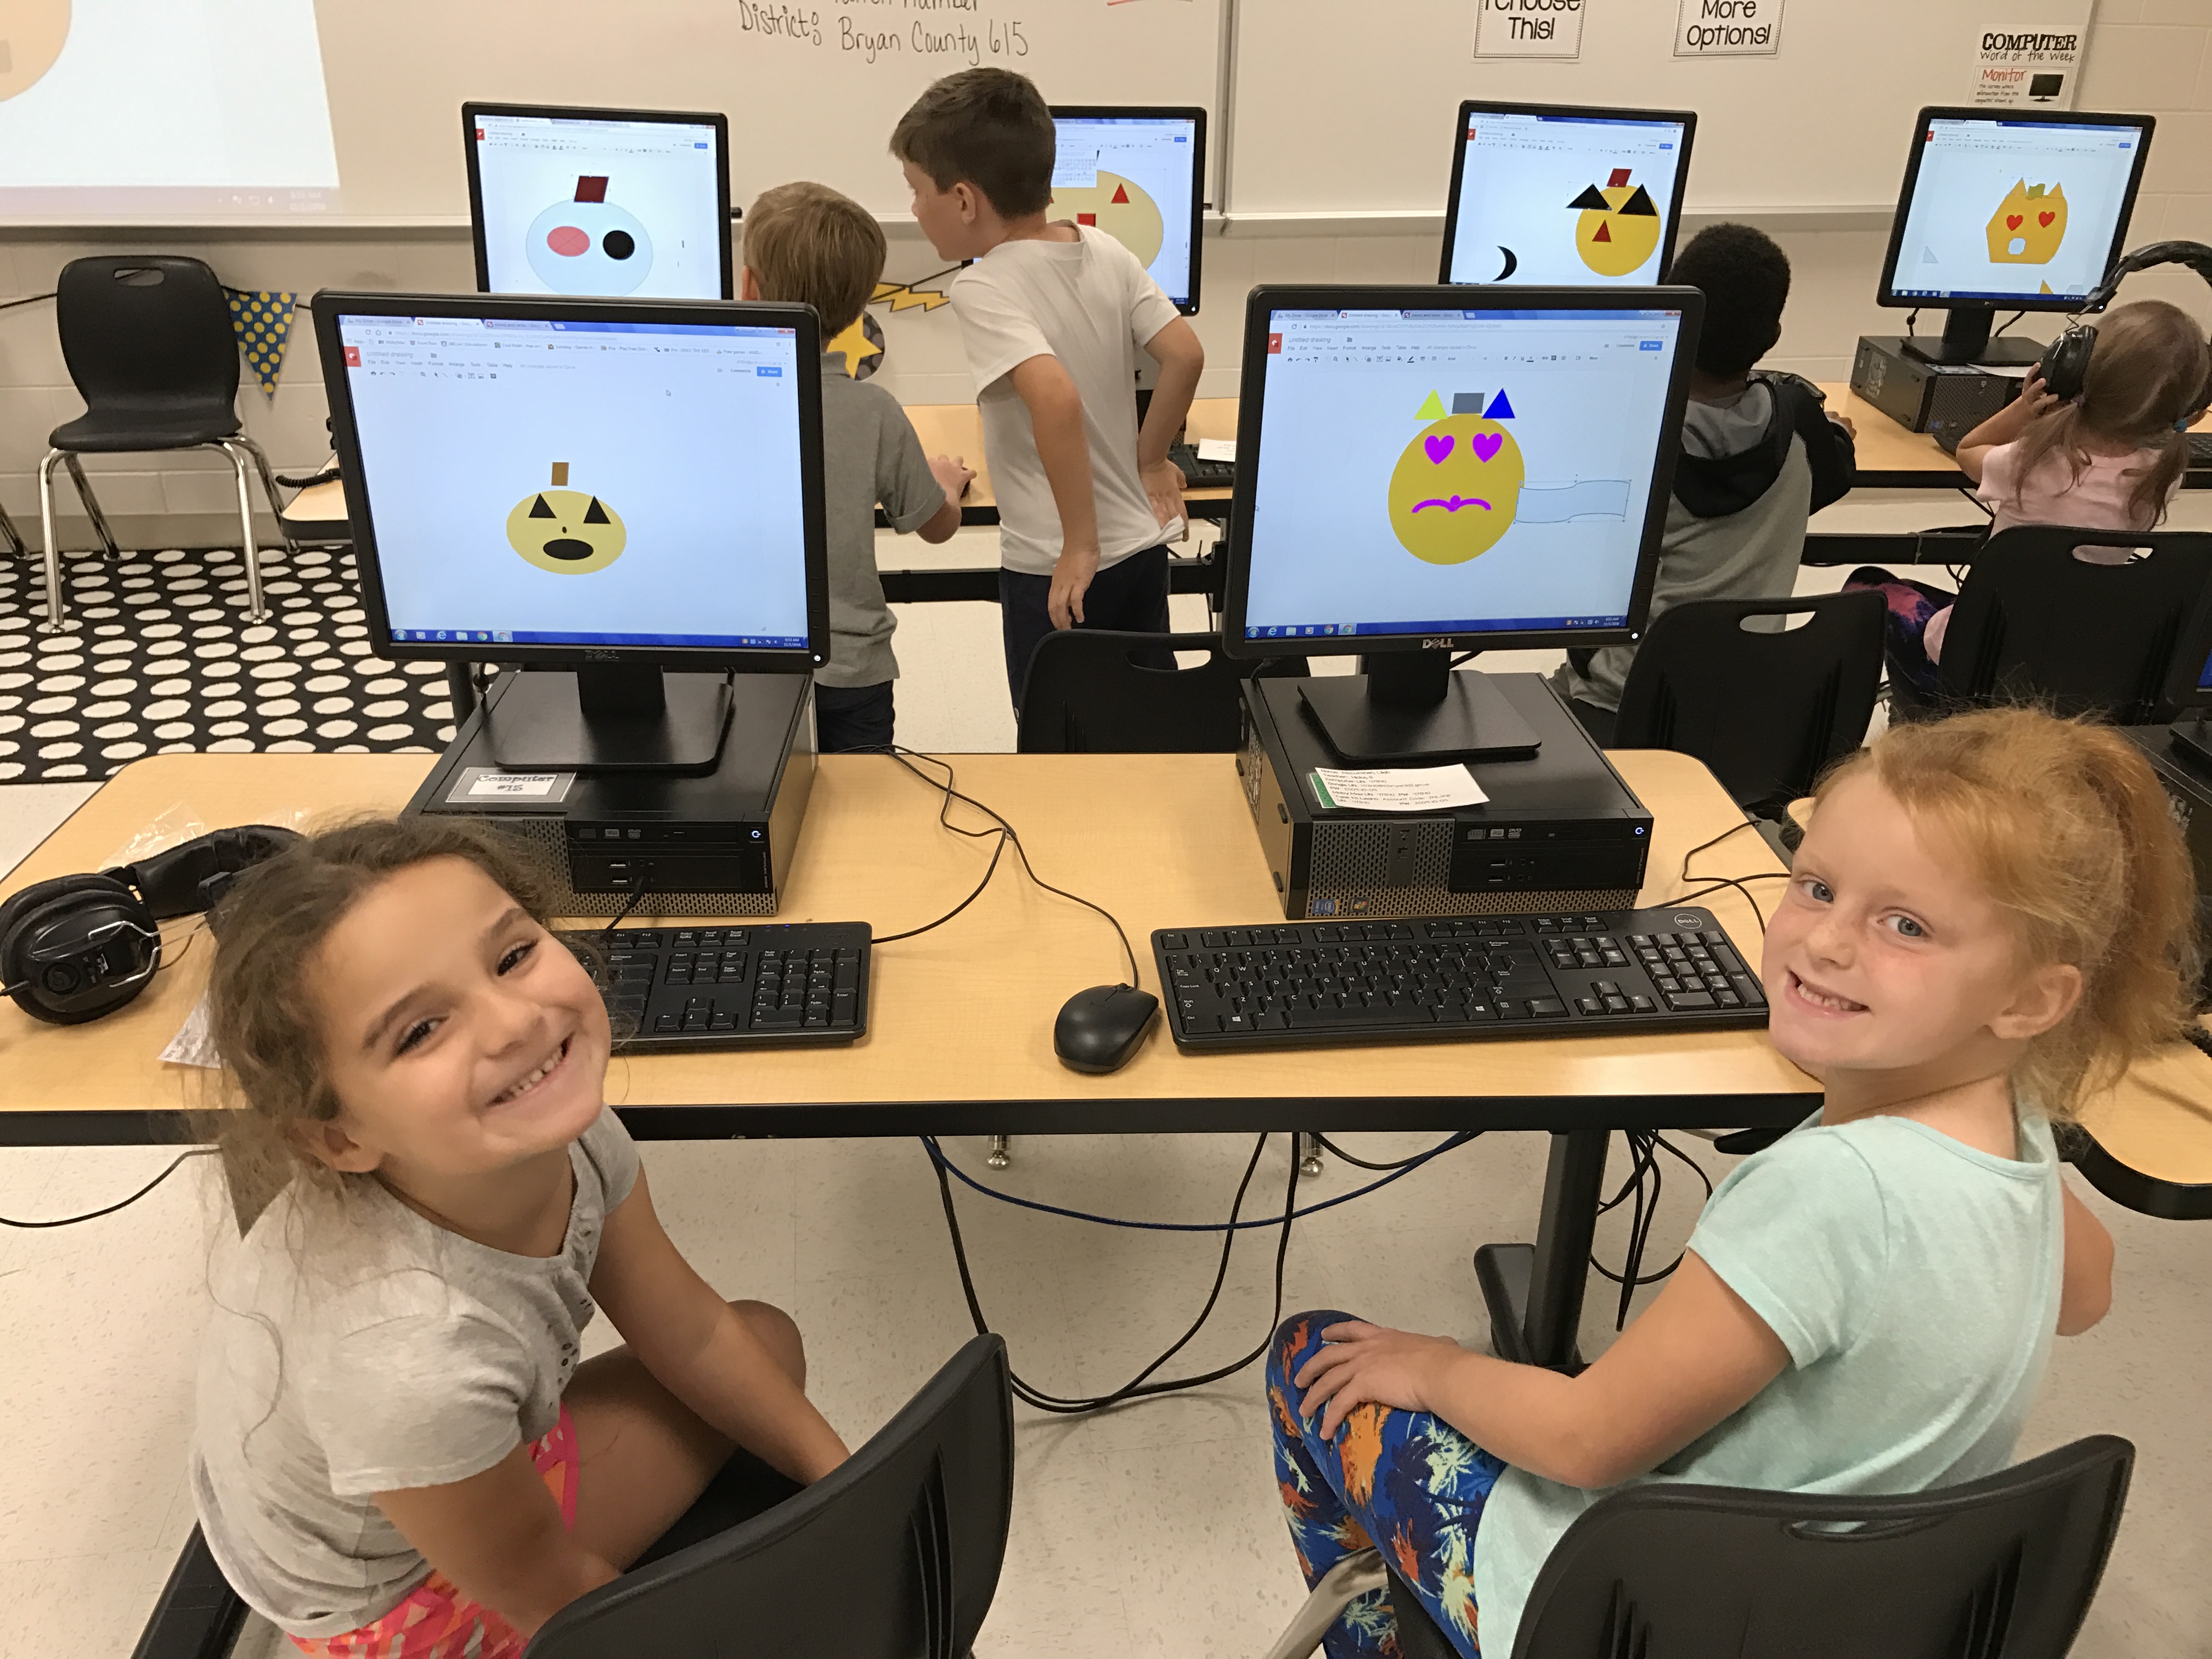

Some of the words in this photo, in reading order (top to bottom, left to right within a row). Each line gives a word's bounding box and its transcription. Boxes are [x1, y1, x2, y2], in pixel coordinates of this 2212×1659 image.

[1702, 0, 1756, 19] More
[1508, 17, 1555, 40] This!
[1687, 24, 1771, 50] Options!
[838, 16, 900, 64] Bryan
[912, 21, 979, 66] County
[989, 19, 1029, 56] 615
[1982, 33, 2077, 50] COMPUTER
[1980, 50, 2008, 61] Word
[2012, 48, 2025, 61] of
[2028, 50, 2044, 61] the
[1982, 68, 2027, 82] Monitor
[1422, 638, 1454, 649] DELL
